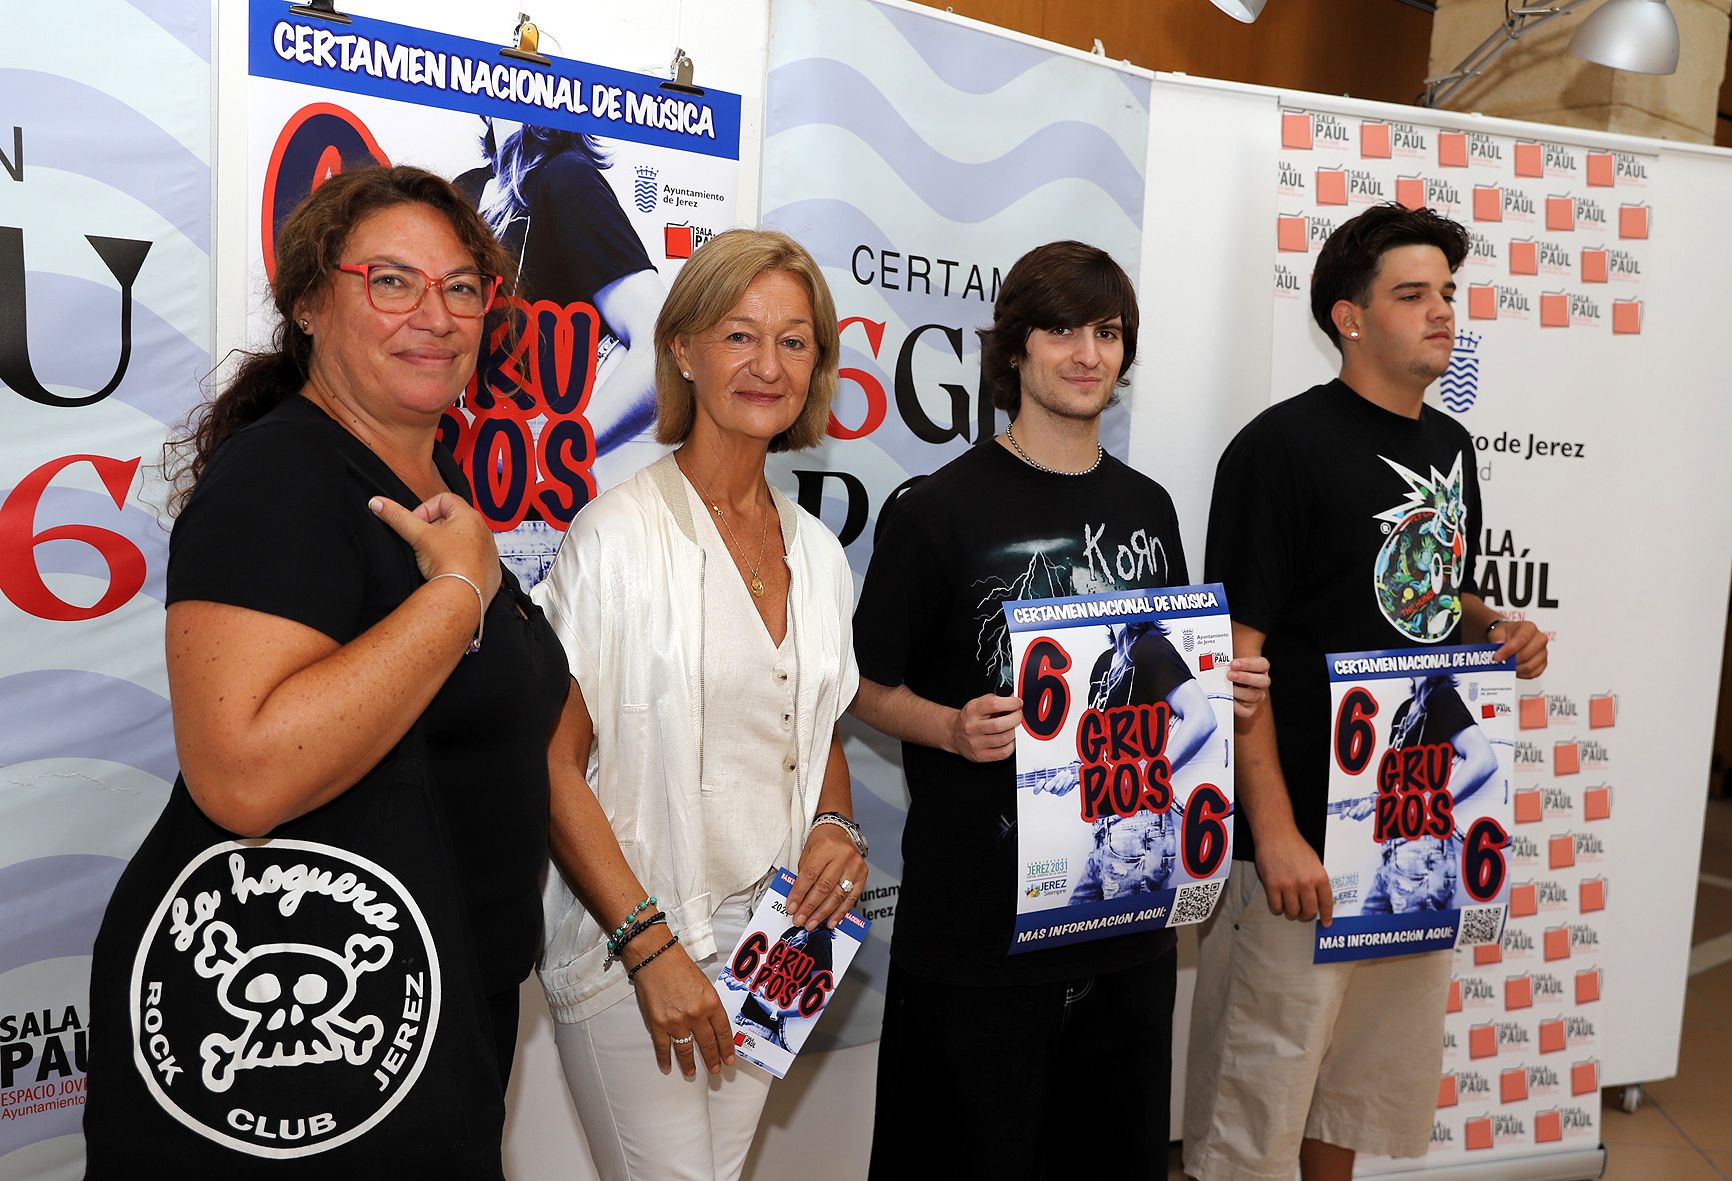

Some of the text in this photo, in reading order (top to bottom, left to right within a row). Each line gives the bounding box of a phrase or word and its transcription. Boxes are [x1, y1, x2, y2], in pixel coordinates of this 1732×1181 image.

[273, 21, 716, 139] CERTAMEN NACIONAL DE MÚSICA
[663, 184, 725, 202] Ayuntamiento
[663, 195, 699, 208] de Jerez
[695, 227, 713, 236] SALA
[850, 244, 1002, 303] CERTA
[1493, 432, 1521, 453] de
[1525, 434, 1585, 460] Jerez
[1480, 549, 1559, 608] AÚL
[1013, 603, 1088, 624] CERTAMEN
[1087, 597, 1154, 618] NACIONAL
[1153, 595, 1170, 612] DE
[1334, 656, 1398, 674] CERTAMEN
[1398, 654, 1452, 671] NACIONAL
[1452, 653, 1466, 667] DE
[1018, 636, 1073, 741] 6
[1077, 702, 1171, 764] GRU
[1334, 686, 1379, 775] 6
[1079, 755, 1174, 822] POS
[1377, 743, 1455, 795] GRU
[1181, 783, 1231, 879] 6
[1373, 790, 1454, 843] POS
[1028, 864, 1050, 876] JEREZ
[1050, 861, 1068, 873] 2031
[1462, 817, 1508, 902] 6
[229, 852, 400, 931] hoguera
[1040, 878, 1068, 892] JEREZ
[1017, 928, 1046, 943] MÁS
[1048, 912, 1134, 938] INFORMACIÓN
[1347, 928, 1423, 947] INFORMACIÓN
[732, 931, 768, 981] 6
[766, 939, 815, 981] GRU
[750, 963, 800, 1009] POS
[798, 970, 834, 1018] 6
[0, 1005, 82, 1043] SALA
[144, 981, 184, 1086] ROCK
[373, 971, 424, 1092] JEREZ
[1, 1083, 55, 1107] ESPACIO
[2, 1095, 86, 1121] Ayuntamiento
[227, 1108, 337, 1140] CLUB
